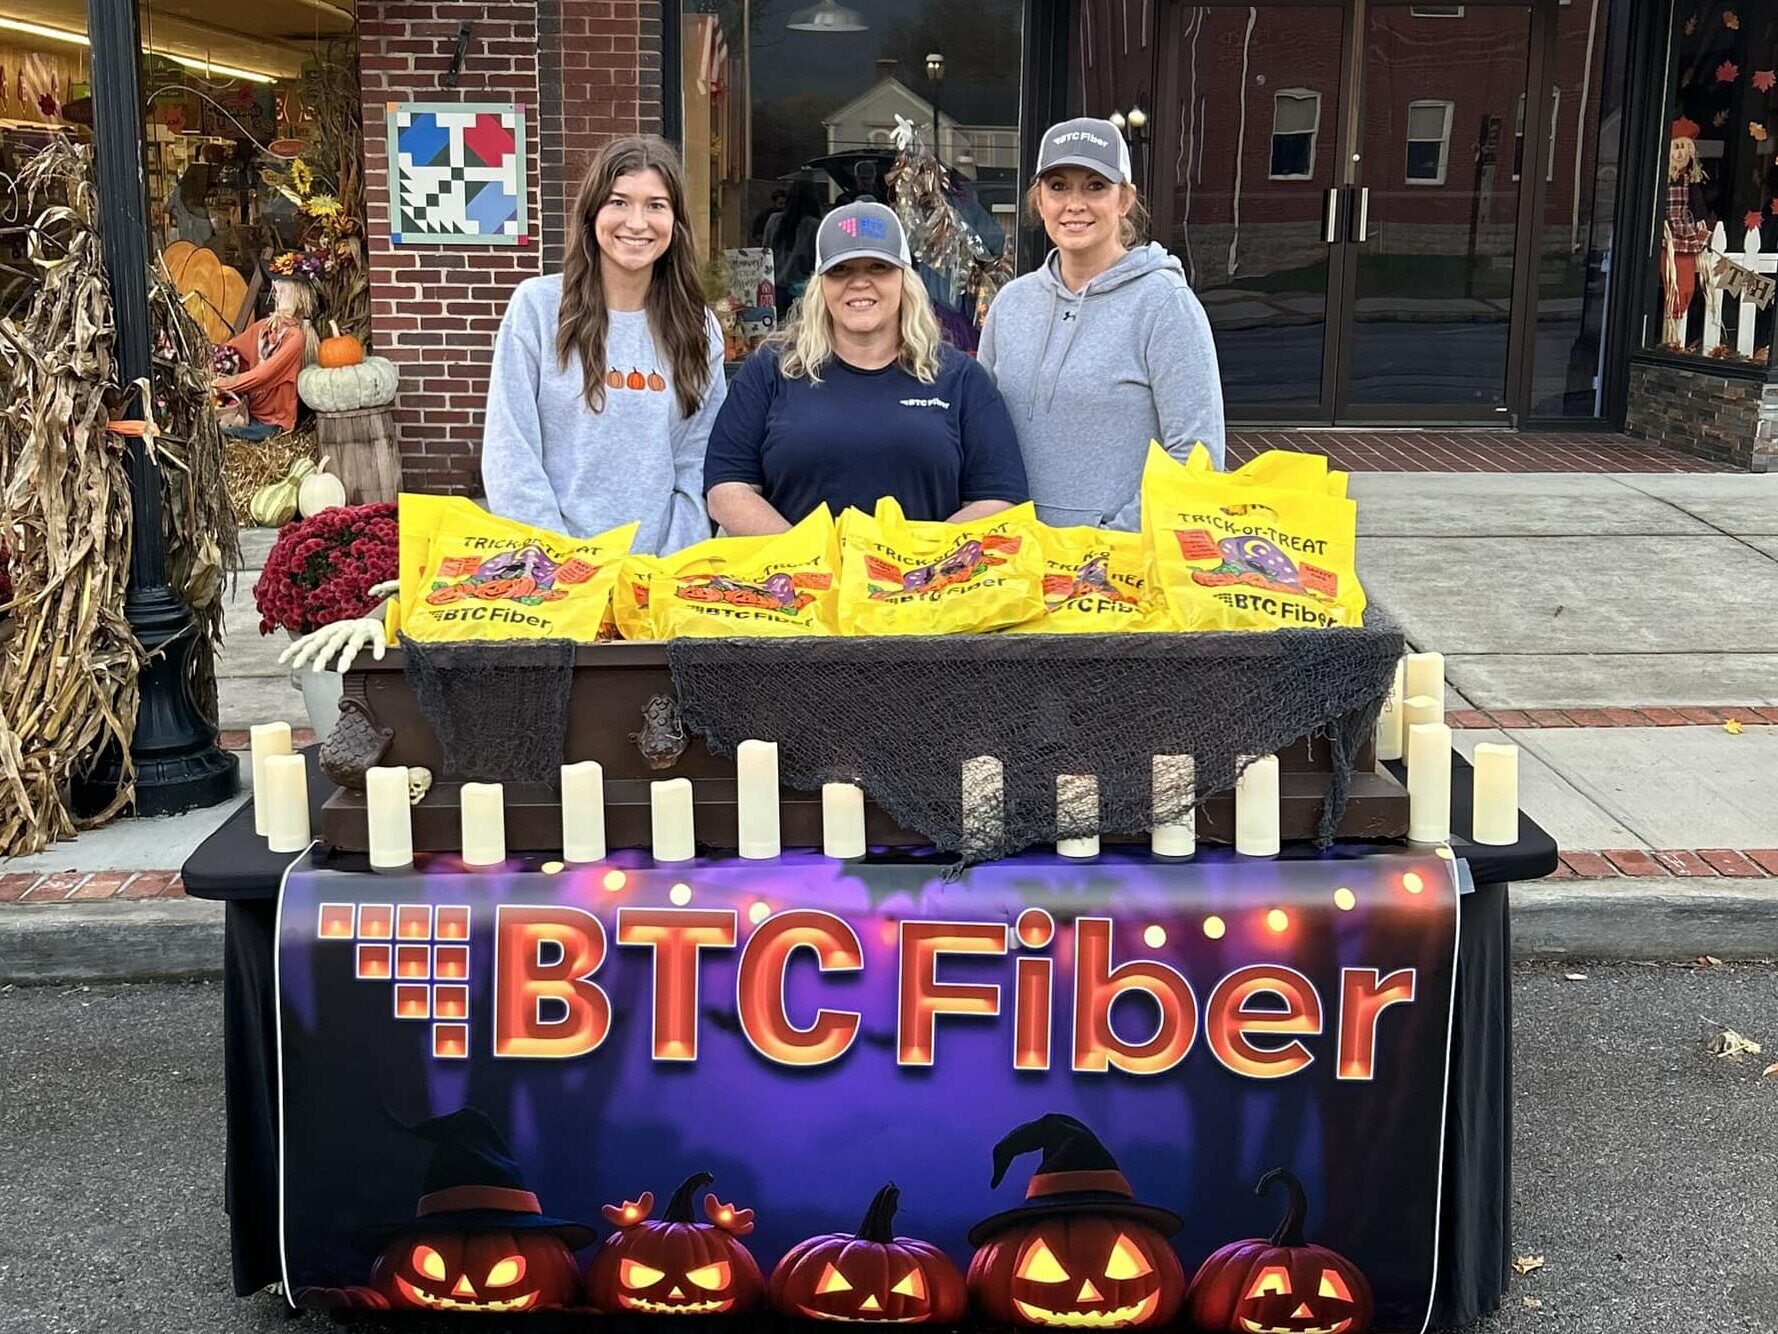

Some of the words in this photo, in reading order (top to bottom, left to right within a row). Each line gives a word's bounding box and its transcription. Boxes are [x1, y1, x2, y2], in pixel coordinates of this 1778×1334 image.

[1060, 132, 1080, 145] BTC
[1081, 132, 1109, 147] Fiber
[443, 606, 488, 621] BTC
[489, 607, 552, 628] Fiber
[706, 607, 750, 619] BTC
[1234, 594, 1277, 615] BTC
[1281, 602, 1338, 627] Fiber
[494, 905, 865, 1066] BTC
[897, 907, 1417, 1080] Fiber
